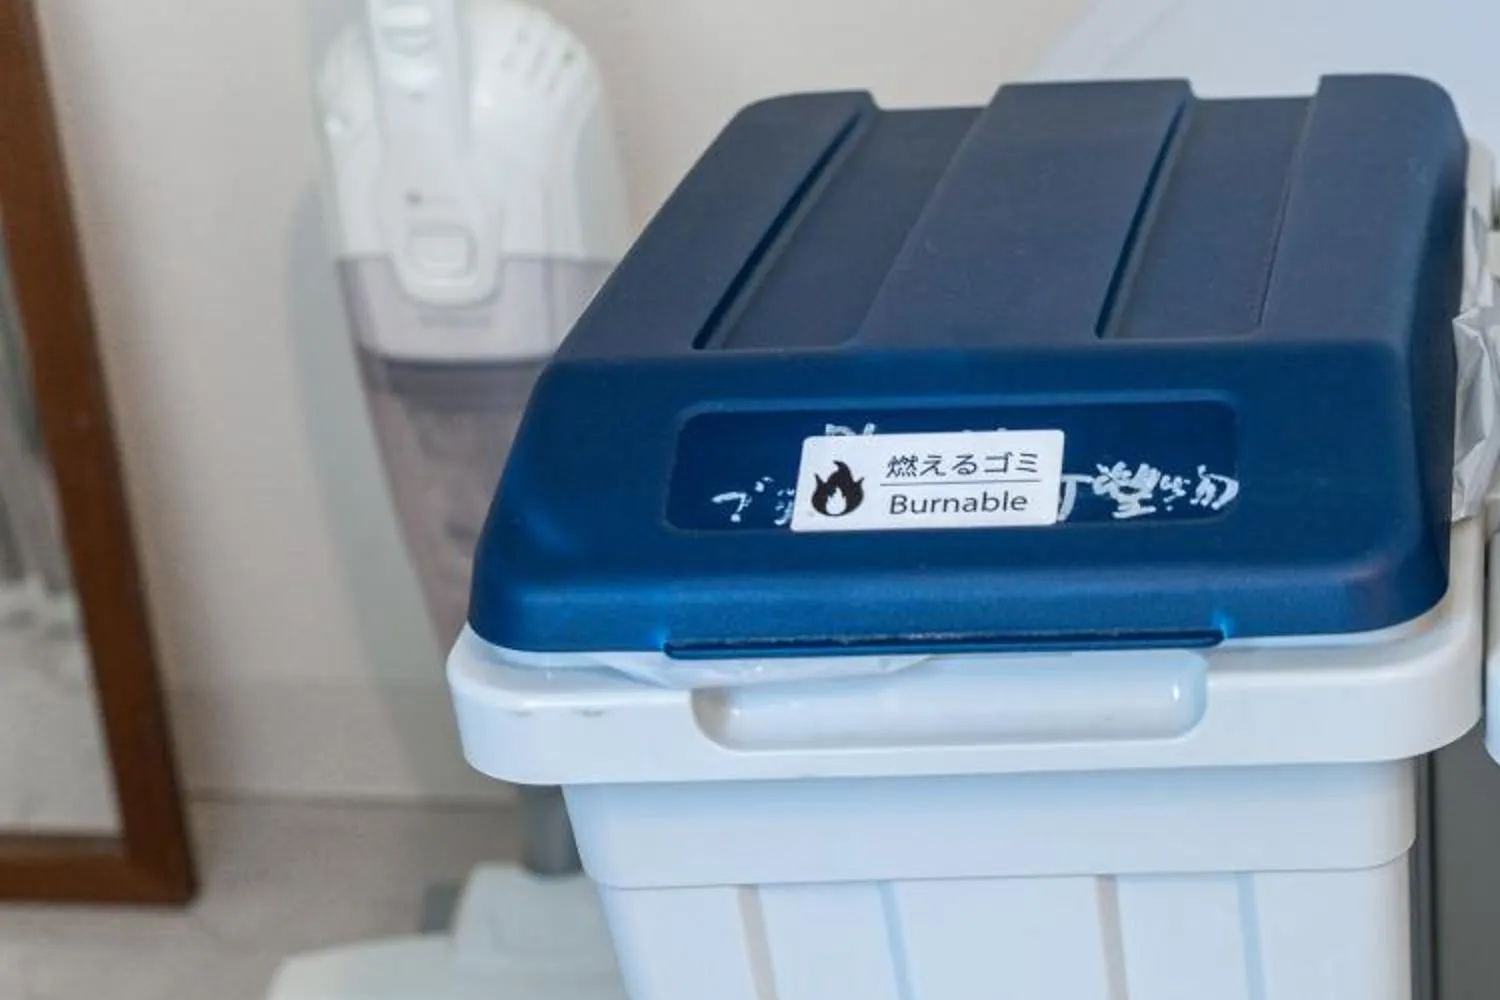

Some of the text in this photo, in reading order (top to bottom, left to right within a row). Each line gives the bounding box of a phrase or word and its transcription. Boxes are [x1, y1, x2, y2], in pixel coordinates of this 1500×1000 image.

[886, 452, 1038, 478] 燃えるゴミ
[890, 491, 1028, 515] Burnable
